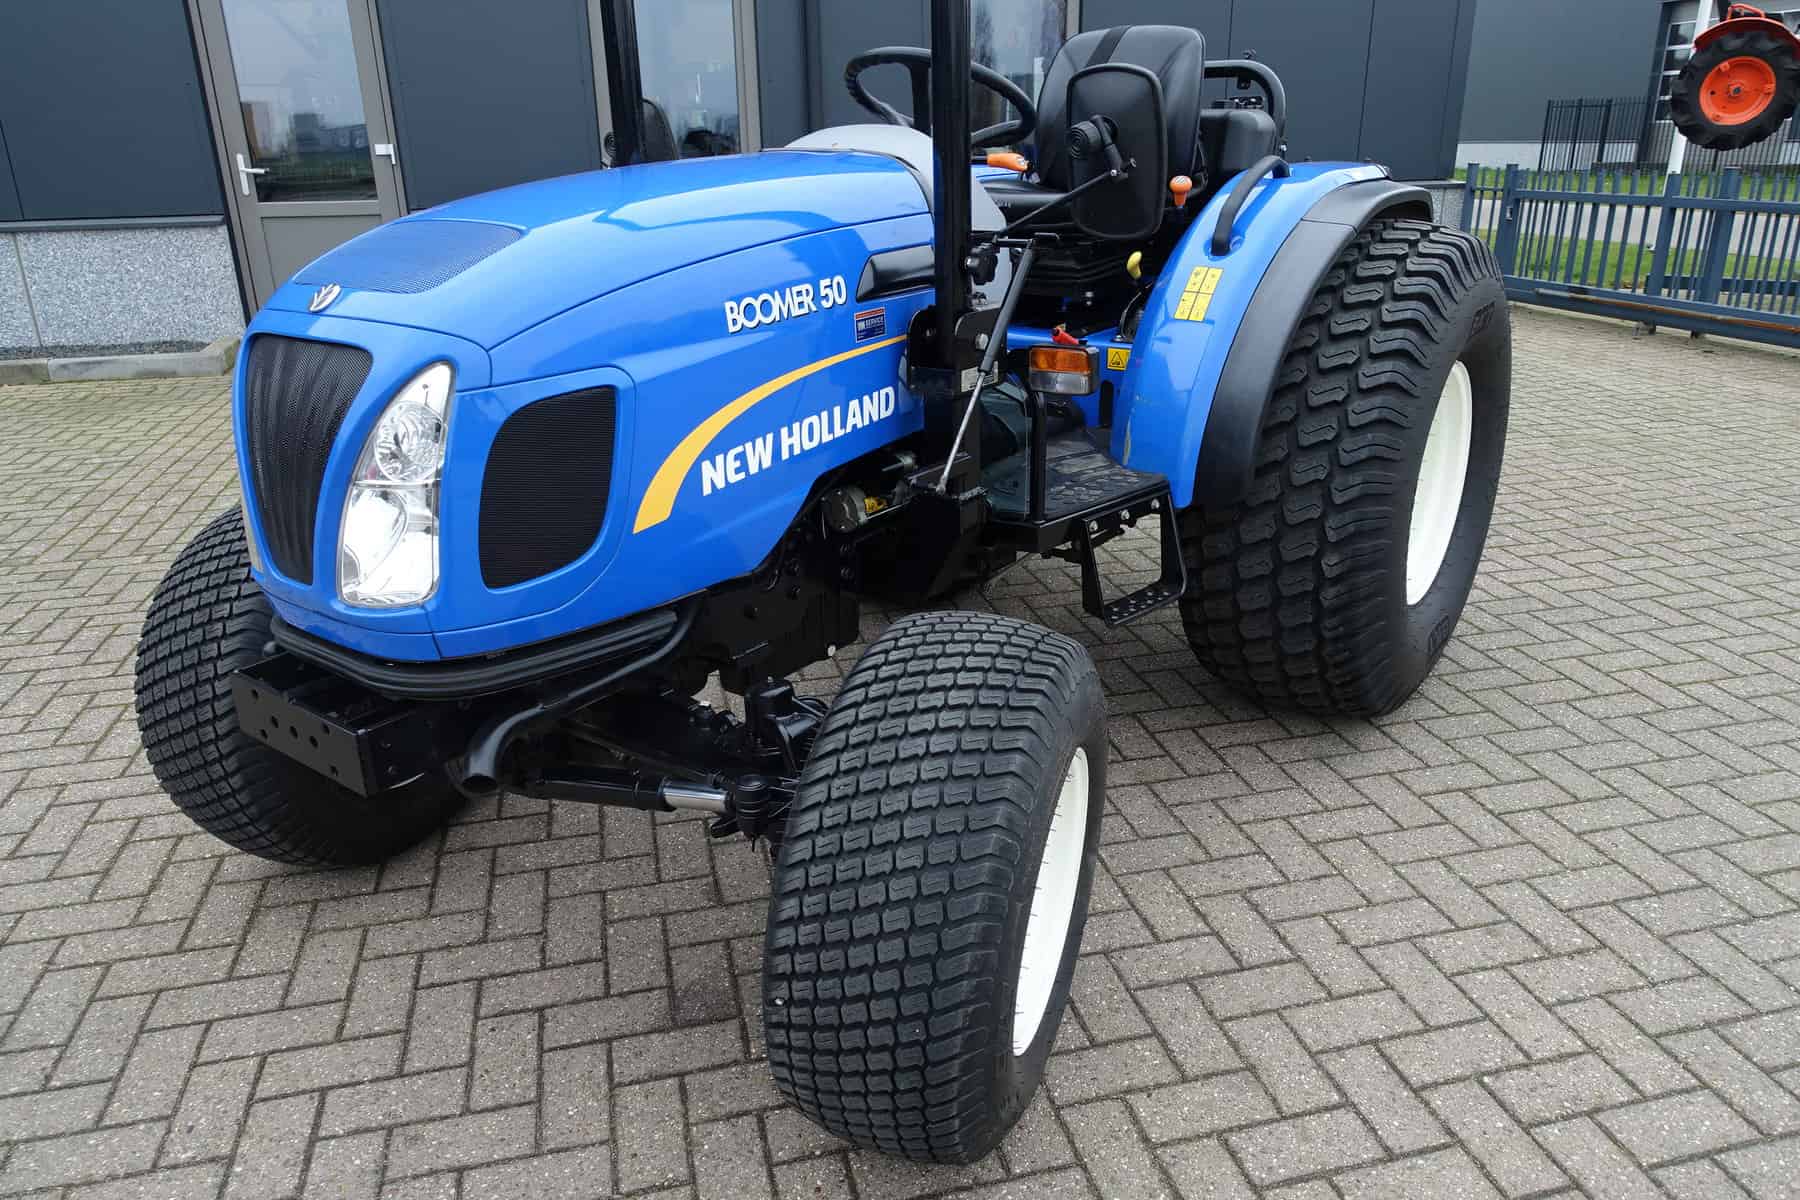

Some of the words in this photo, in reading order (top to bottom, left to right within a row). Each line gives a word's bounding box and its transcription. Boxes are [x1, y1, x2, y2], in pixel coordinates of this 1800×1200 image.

[724, 283, 816, 334] BOOMER
[819, 275, 847, 307] 50
[701, 431, 774, 497] NEW
[780, 387, 895, 461] HOLLAND
